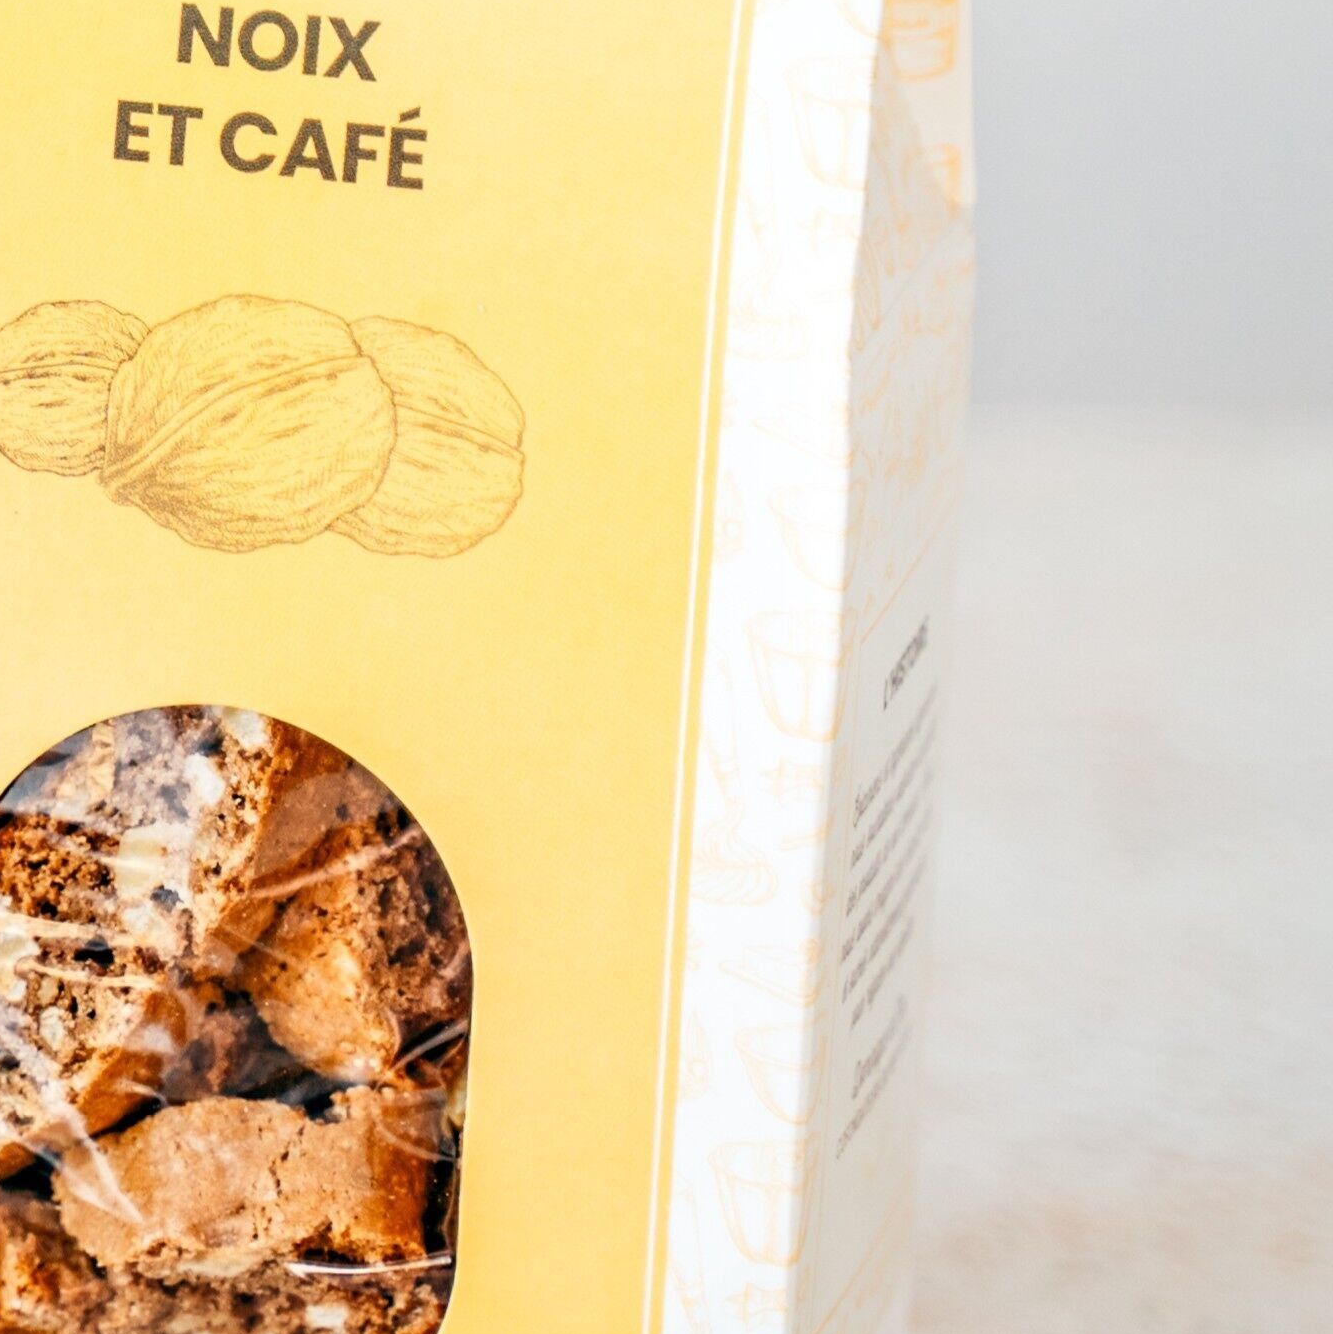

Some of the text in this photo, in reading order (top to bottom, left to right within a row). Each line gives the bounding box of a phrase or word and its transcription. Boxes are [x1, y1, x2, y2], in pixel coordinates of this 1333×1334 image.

[176, 2, 381, 82] NOIX
[113, 99, 428, 191] ET CAFÉ
